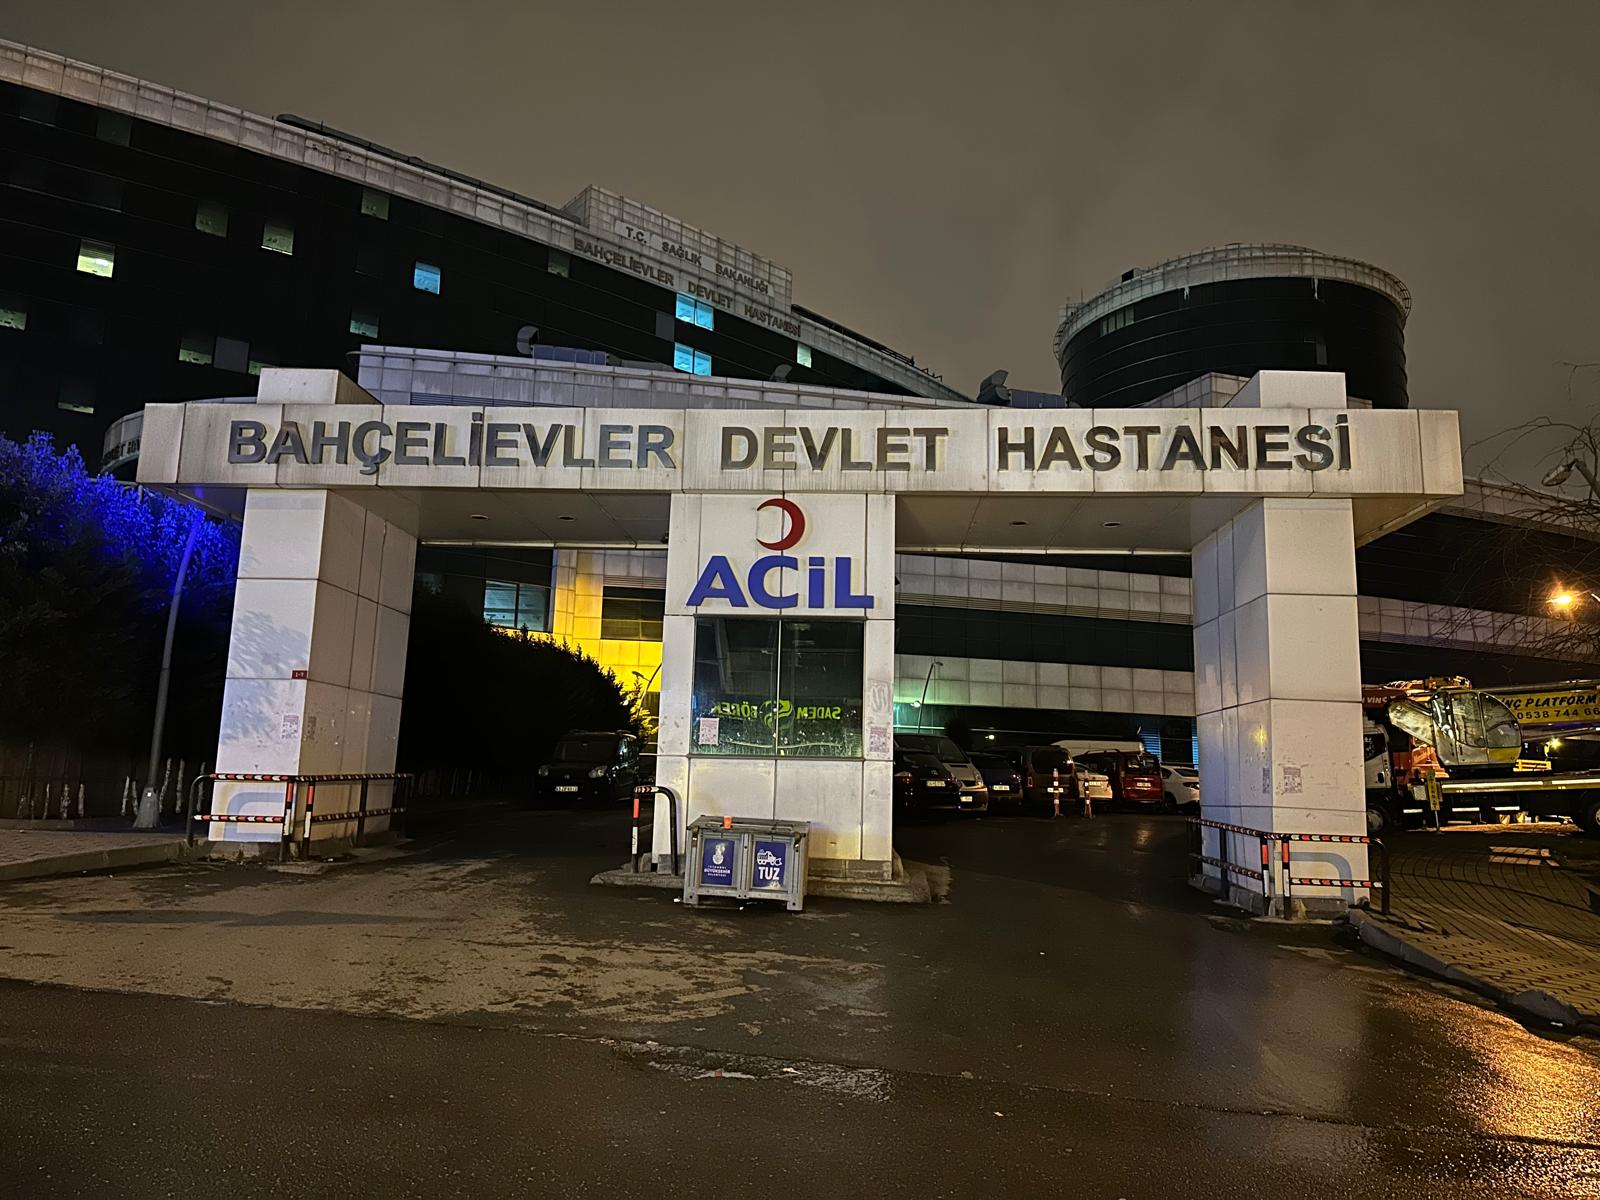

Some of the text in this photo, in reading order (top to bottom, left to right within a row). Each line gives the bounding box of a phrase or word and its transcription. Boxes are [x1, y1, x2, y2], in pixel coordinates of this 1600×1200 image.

[625, 226, 769, 295] T.C. SAĞLIK BAKANLIĞI
[574, 238, 801, 337] BAHÇELİEVLER DEVLET HASTANESİ
[228, 412, 1352, 475] BAHÇELİEVLER DEVLET HASTANESİ
[1517, 711, 1550, 720] 0538
[1554, 709, 1579, 717] 744
[1525, 695, 1597, 708] PLATFORM
[758, 866, 780, 880] TUZ
